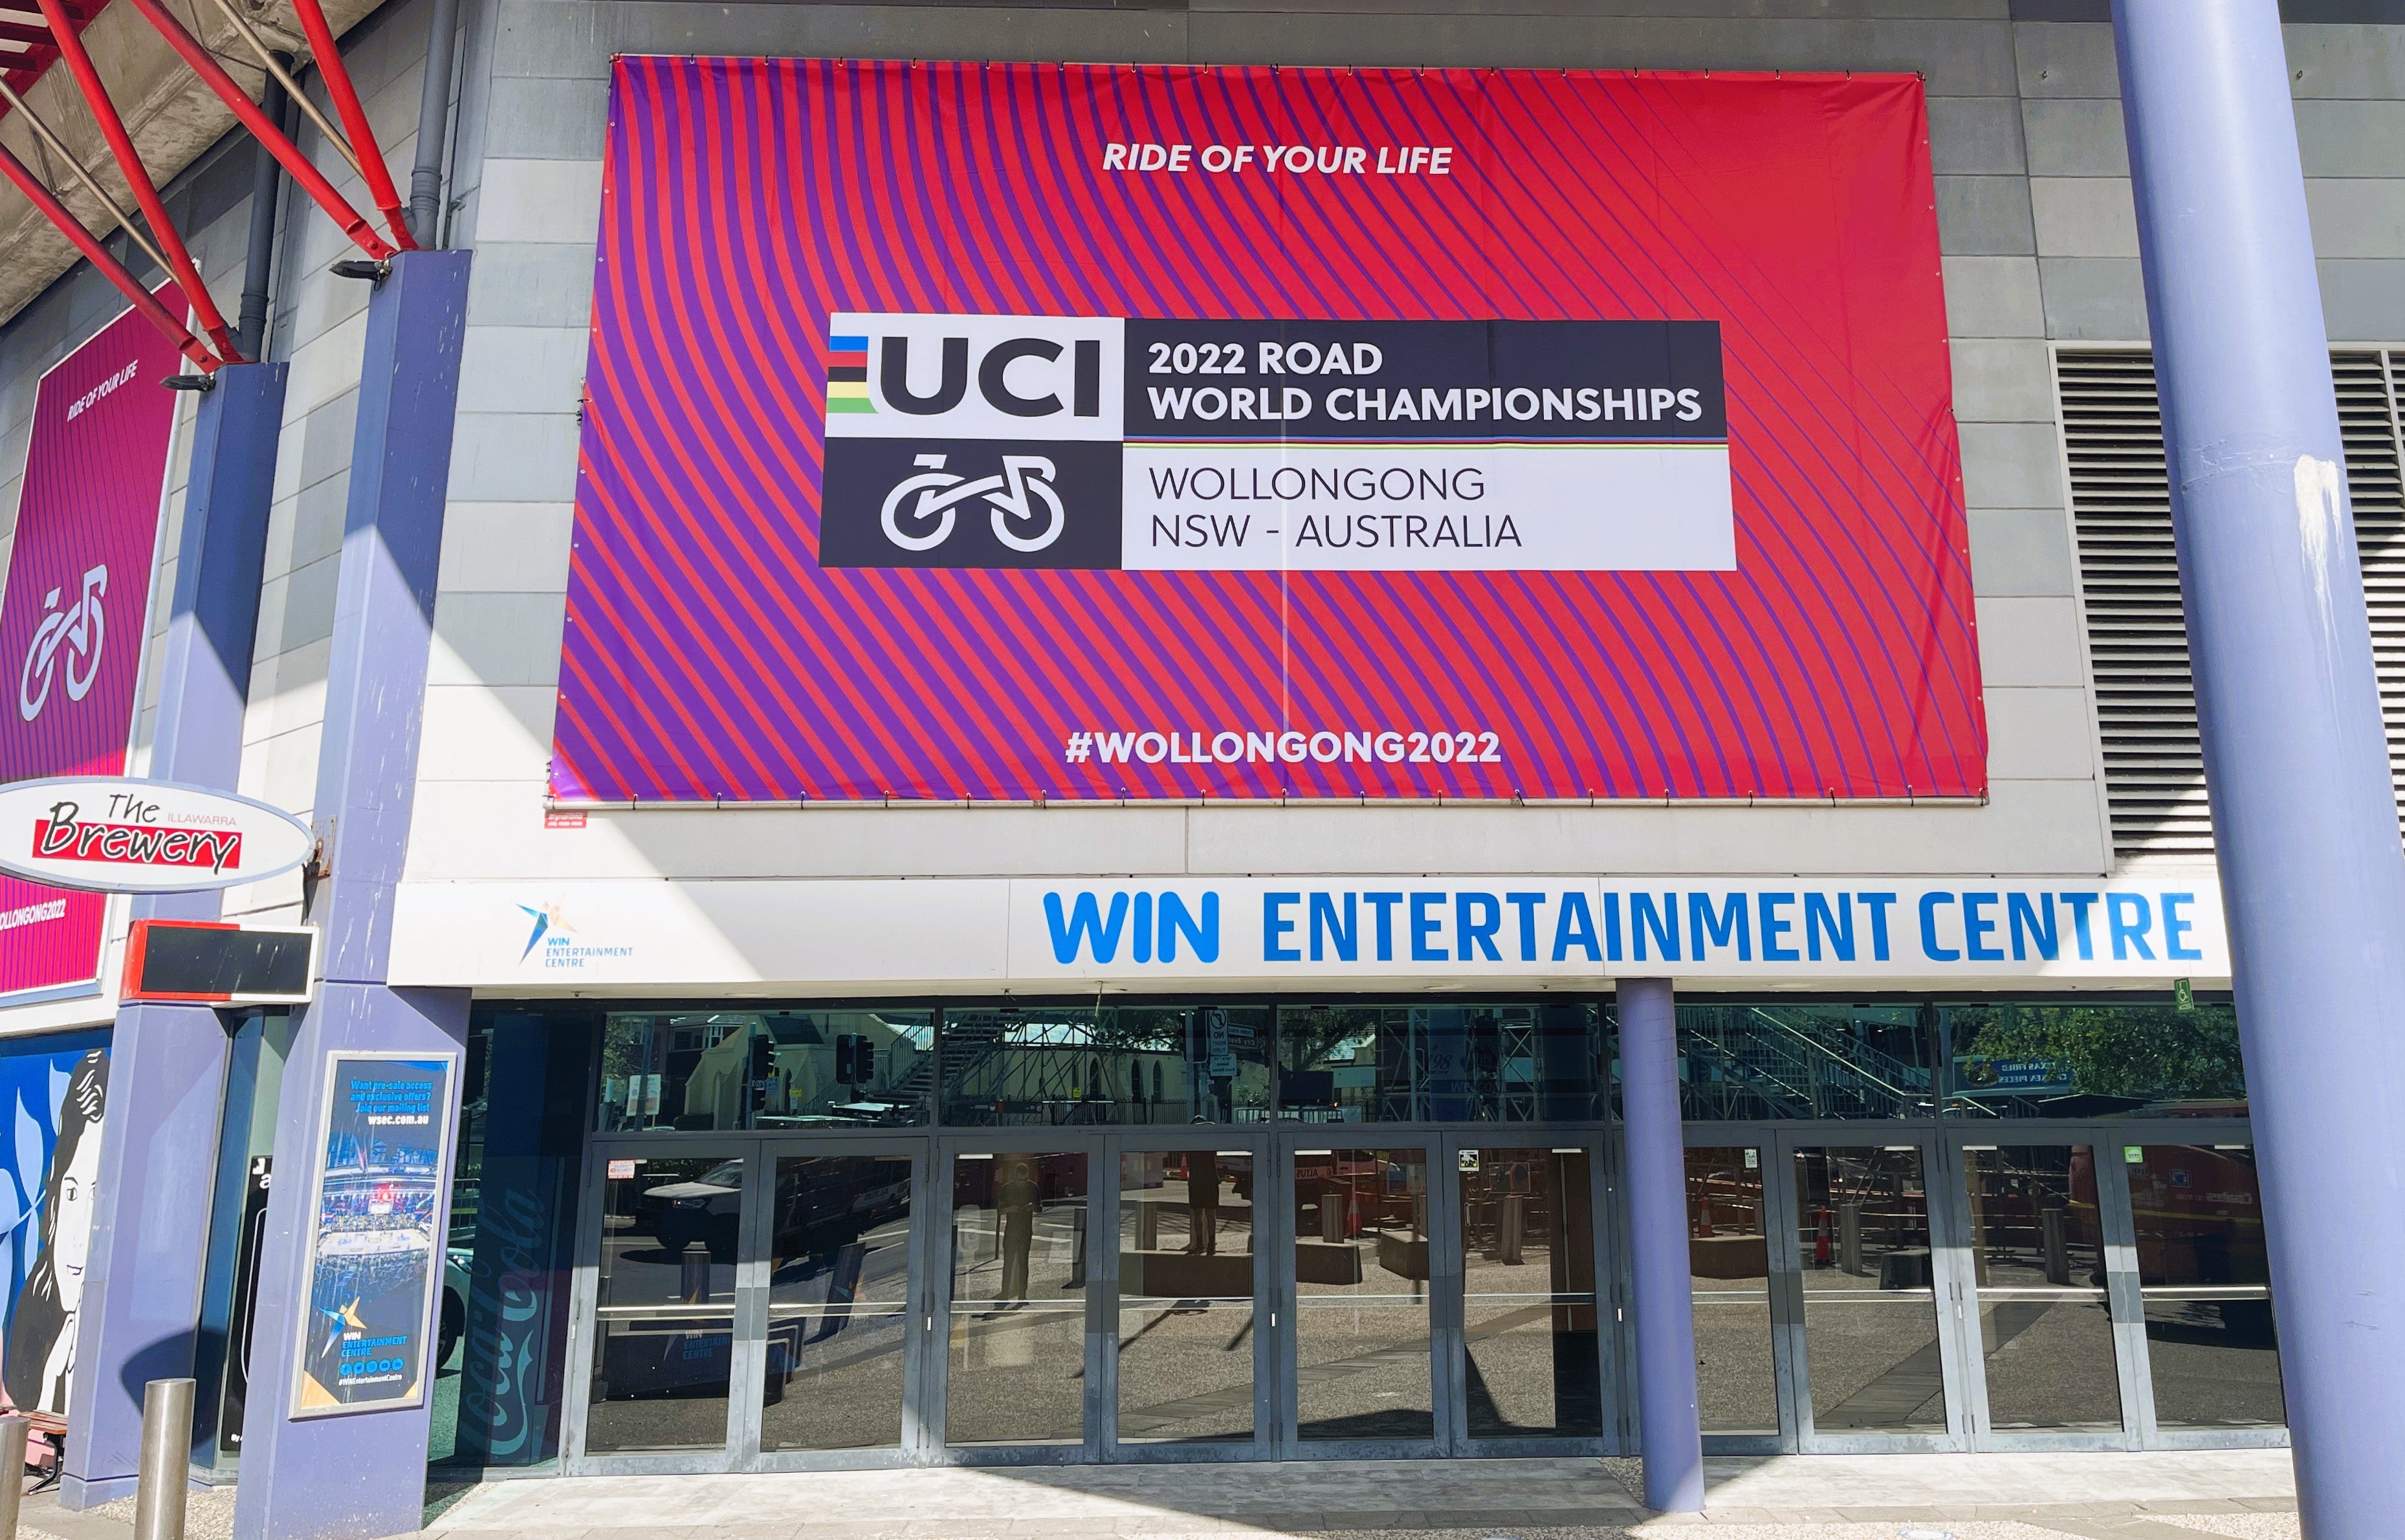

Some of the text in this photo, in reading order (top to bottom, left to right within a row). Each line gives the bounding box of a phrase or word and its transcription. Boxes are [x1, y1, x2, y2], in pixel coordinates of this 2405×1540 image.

[1103, 143, 1453, 175] RIDE OF YOUR LIFE
[1148, 342, 1383, 375] 2022 ROAD
[67, 359, 138, 423] RIDE OF YOUR LIFE
[881, 336, 1100, 417] UCI
[1147, 387, 1702, 421] WORLD CHAMPIONSHIPS
[1148, 467, 1484, 501] WOLLONGONG
[1152, 514, 1251, 547] NSW
[1295, 514, 1522, 548] AUSTRALIA
[1065, 731, 1501, 764] #WOLLONGONG2022
[109, 794, 160, 823] The
[167, 813, 237, 826] ILLAWARRA
[42, 802, 238, 875] Brewery
[0, 898, 66, 931] OLLONGONG2022
[1043, 891, 2202, 964] WIN ENTERTAINMENT CENTRE
[546, 947, 633, 957] ENTERTAINMENT
[547, 938, 570, 947] WIN
[545, 958, 585, 967] CENTRE
[350, 1092, 432, 1101] and exclusive offers?
[351, 1080, 372, 1090] Want
[373, 1081, 406, 1091] pre-sale
[368, 1116, 429, 1125] wsec.com.au
[388, 1103, 416, 1114] mailing
[417, 1103, 430, 1112] list
[342, 1335, 408, 1349] ENTERTAINMENT
[343, 1331, 362, 1341] WIN
[341, 1347, 372, 1358] CENTRE
